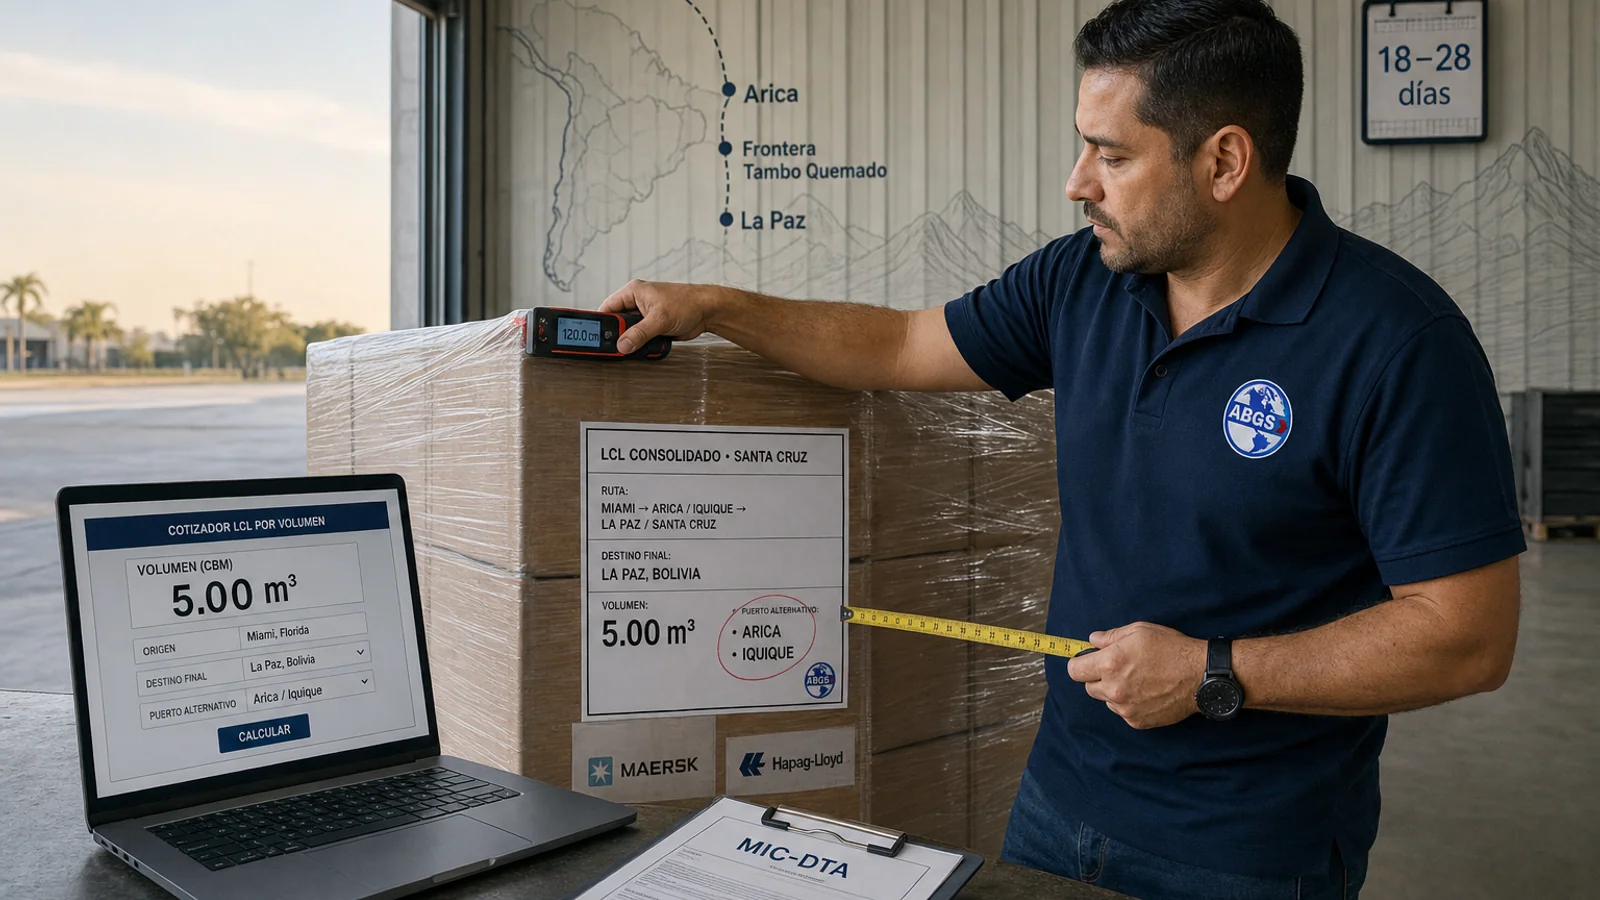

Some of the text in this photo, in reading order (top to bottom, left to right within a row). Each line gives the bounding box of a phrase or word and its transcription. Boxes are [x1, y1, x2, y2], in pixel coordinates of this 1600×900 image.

[743, 83, 799, 104] Arica
[1398, 80, 1450, 105] días
[742, 140, 817, 157] Frontera
[743, 162, 888, 180] Tambo Quemado
[740, 211, 806, 231] La Paz
[563, 328, 599, 341] 120.0 cm
[1229, 405, 1276, 430] ABGS
[601, 447, 808, 463] LCL CONSOLIDADO SANTA CRUZ
[601, 485, 628, 496] RUTA:
[601, 503, 635, 514] MIAMI
[651, 503, 683, 514] ARICA
[693, 503, 733, 515] IQUIQUE
[168, 516, 325, 535] COTIZADOR LCL POR VOLUMEN
[601, 519, 616, 530] LA
[619, 519, 641, 530] PAZ
[652, 519, 686, 530] SANTA
[689, 519, 716, 530] CRUZ
[601, 551, 671, 560] DESTINO FINAL:
[137, 557, 233, 576] VOLUMEN (CBM)
[601, 567, 701, 582] LA PAZ, BOLIVIA
[171, 578, 253, 618] 5.00
[601, 601, 648, 610] VOLUMEN:
[246, 624, 310, 642] Miami, Florida
[601, 619, 660, 647] 5.00
[742, 625, 781, 639] ARICA
[142, 643, 176, 657] ORIGEN
[742, 646, 794, 661] IQUIQUE
[250, 653, 316, 672] La Paz, Bolivia
[145, 671, 207, 689] DESTINO FINAL
[807, 676, 830, 684] ABGS
[253, 690, 279, 704] Arica
[288, 684, 323, 702] Iquique
[148, 699, 237, 721] PUERTO ALTERNATIVO
[238, 724, 291, 741] CALCULAR
[620, 756, 698, 778] MAERSK
[772, 751, 843, 772] Hapag-Lloyd
[735, 836, 849, 880] MIC-DTA
